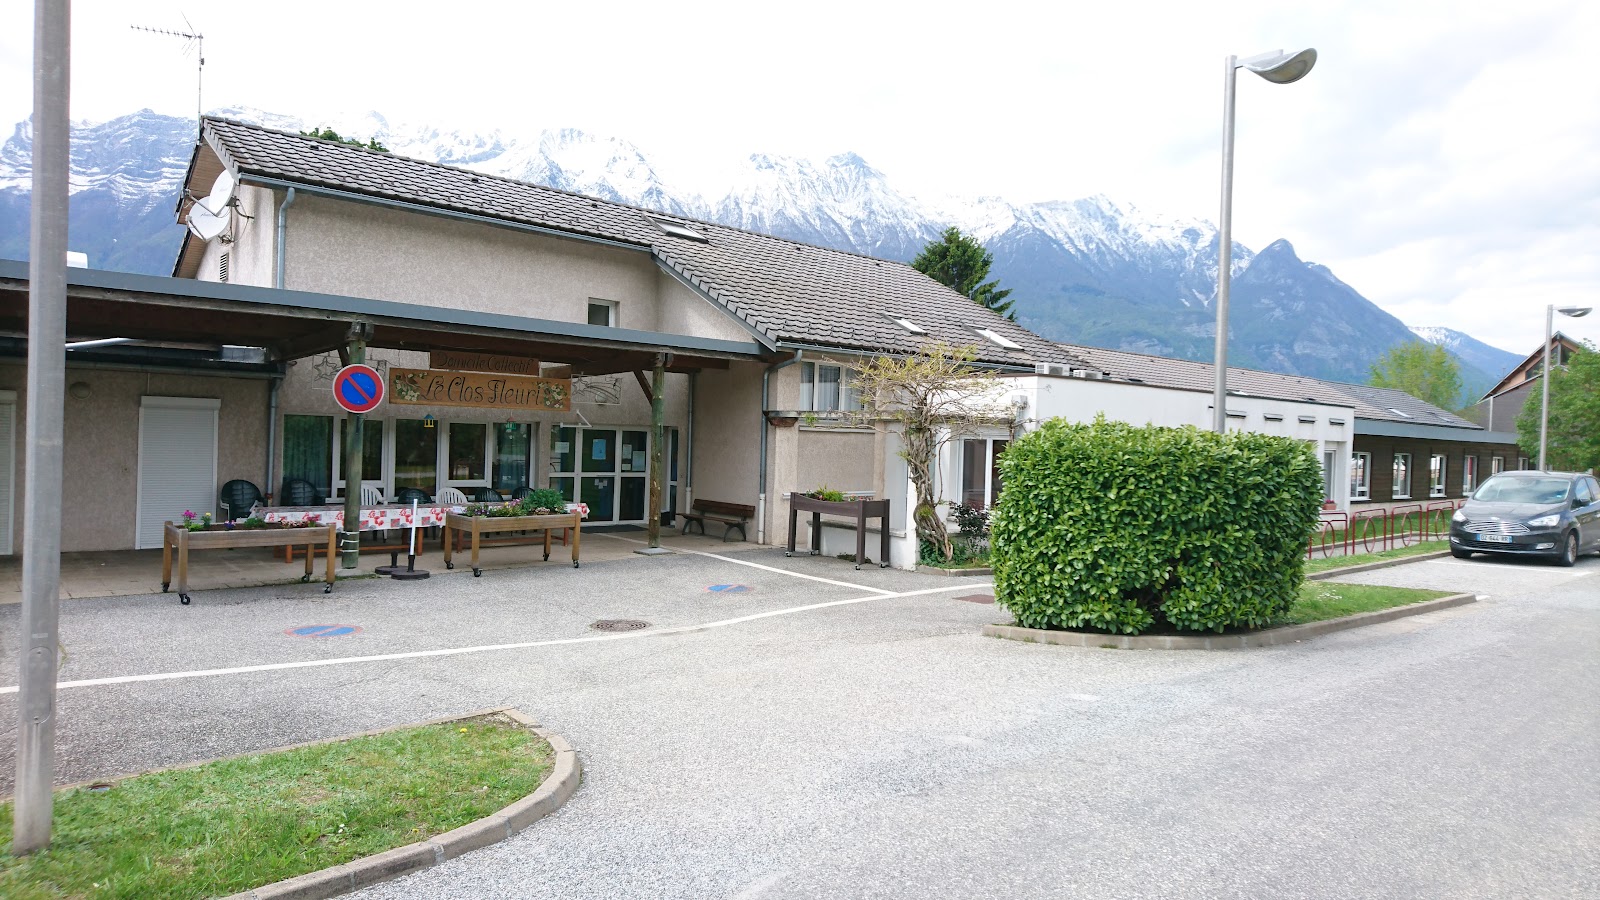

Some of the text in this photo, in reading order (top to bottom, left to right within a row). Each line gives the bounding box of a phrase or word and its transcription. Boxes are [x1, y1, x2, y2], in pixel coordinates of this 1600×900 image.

[437, 352, 534, 373] Domicile Collectif
[421, 376, 541, 406] Le Clos Fleuri
